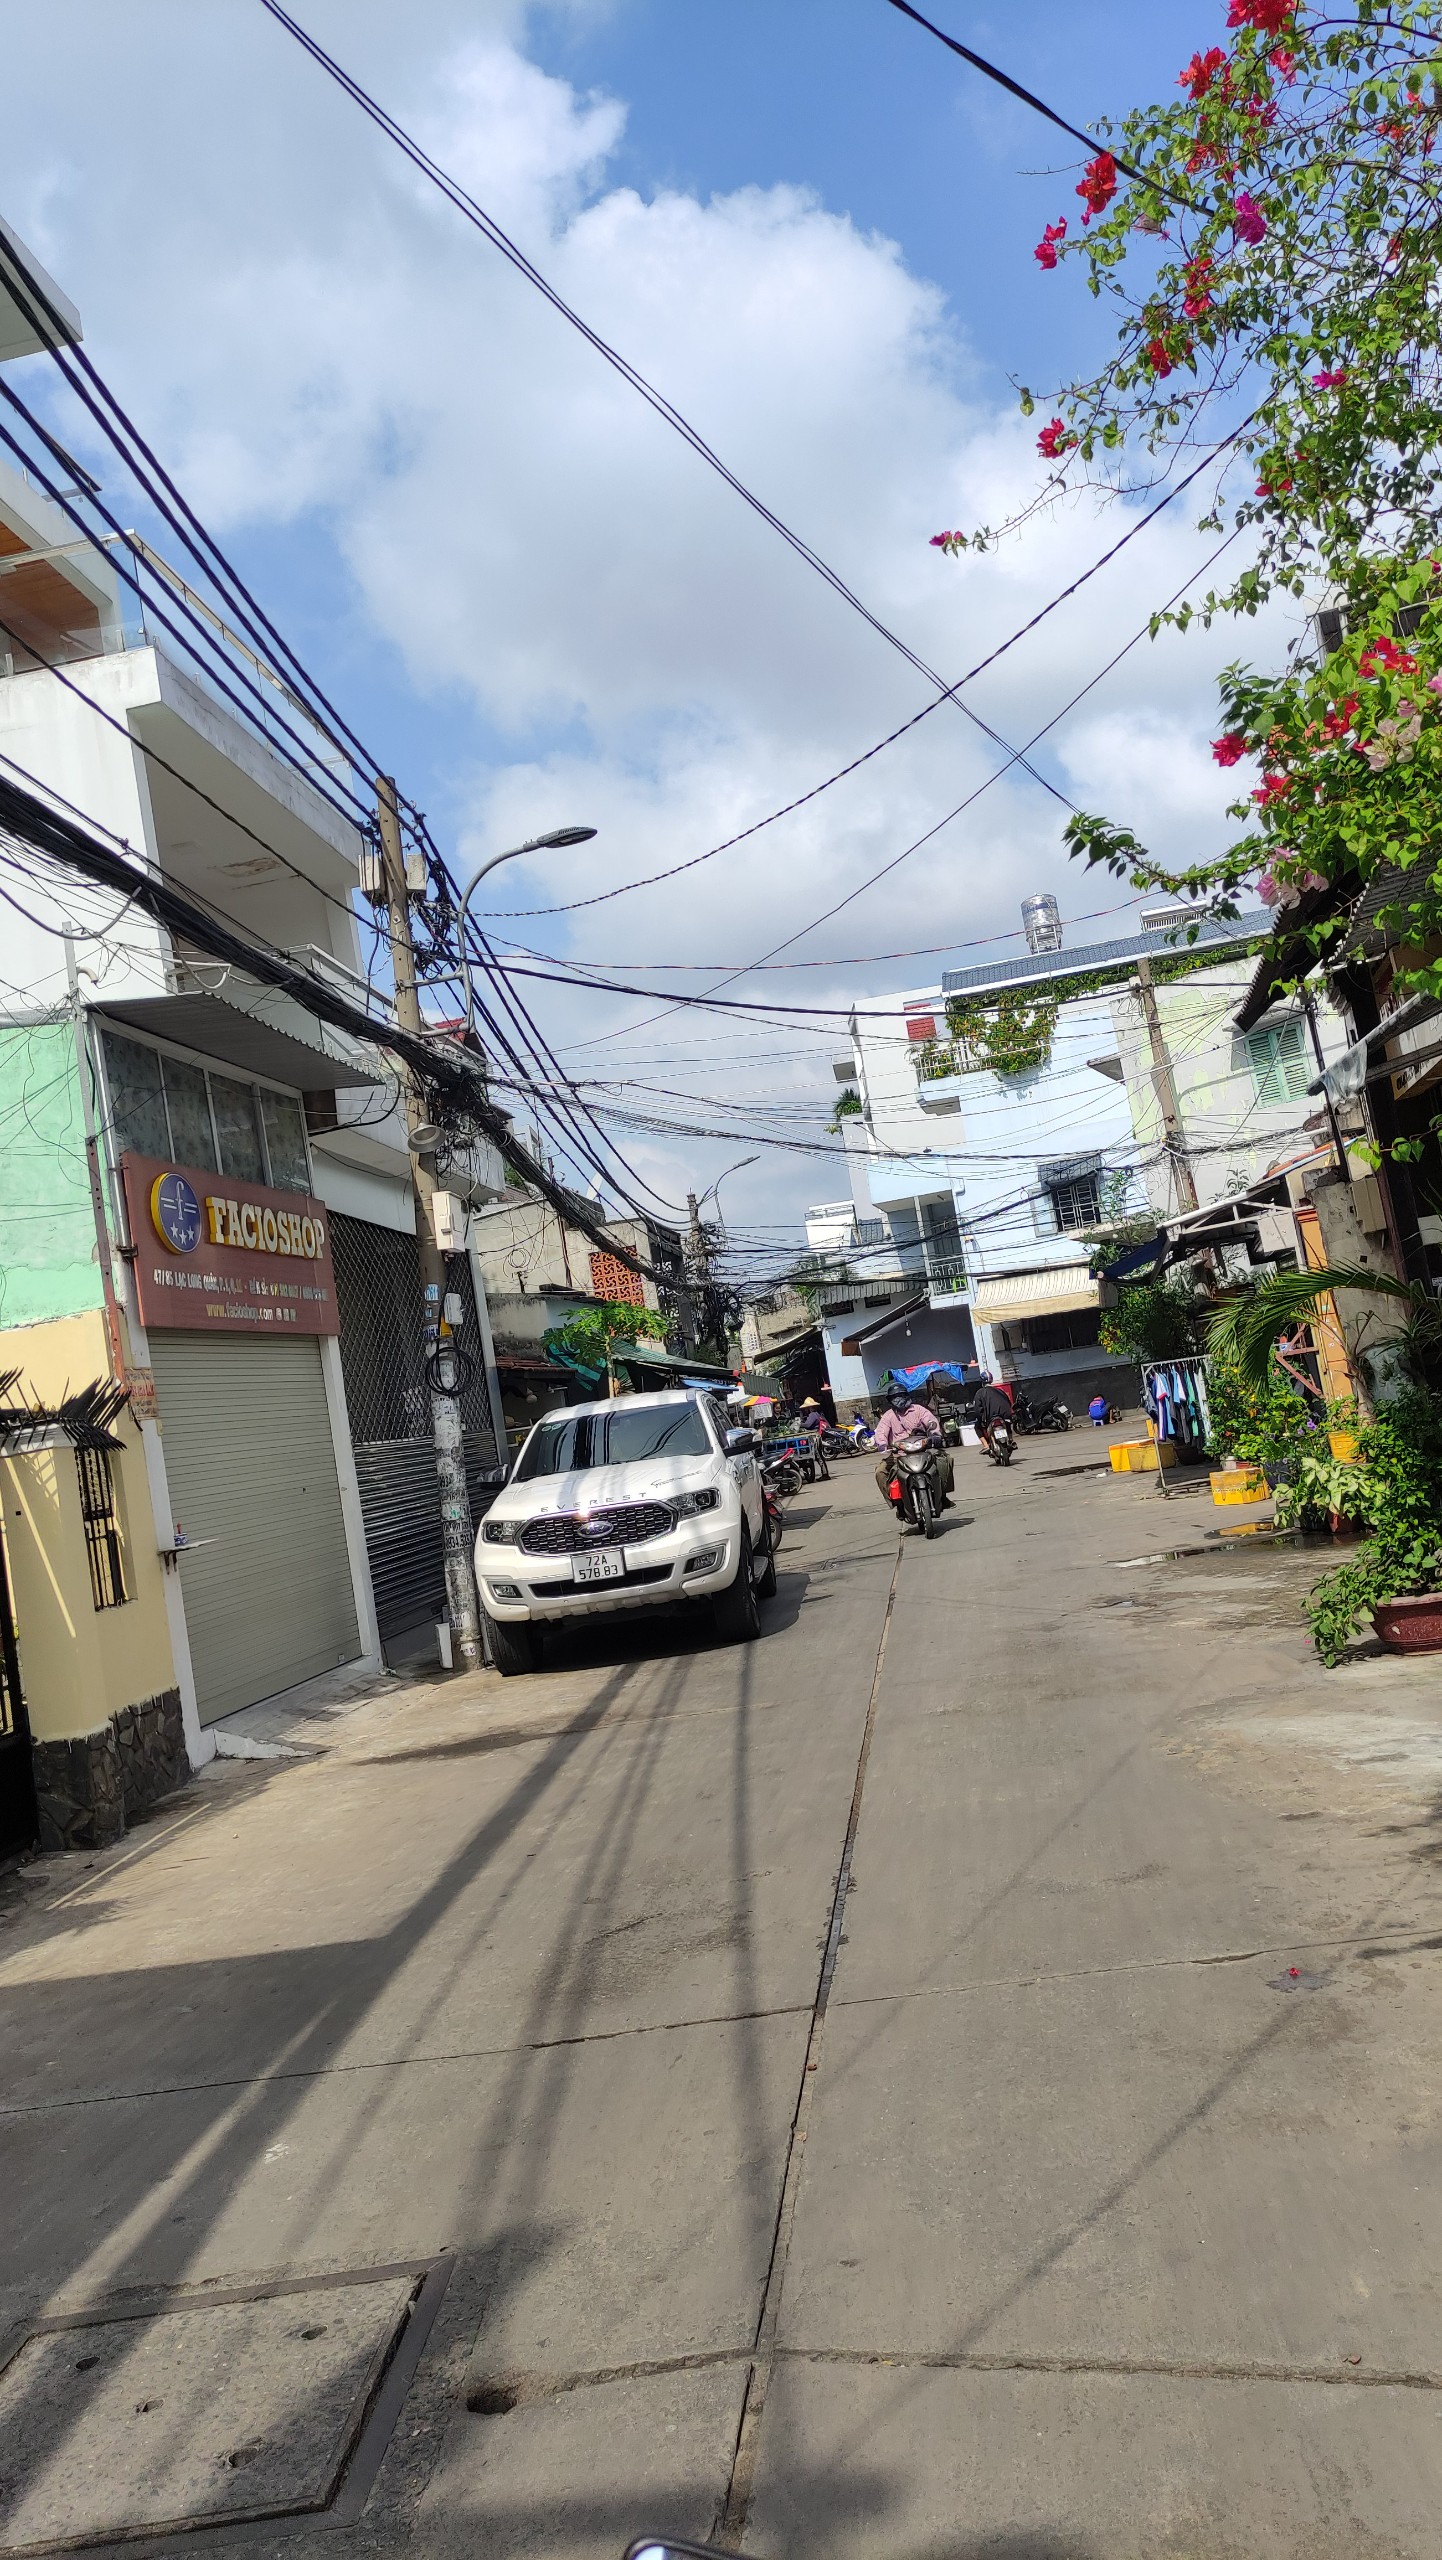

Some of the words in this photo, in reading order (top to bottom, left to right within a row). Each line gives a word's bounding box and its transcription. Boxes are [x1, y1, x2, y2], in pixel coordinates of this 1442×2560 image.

[205, 1196, 325, 1259] FACIOSHOP
[187, 1273, 203, 1289] LONG
[206, 1302, 273, 1323] www.facioshop.com
[540, 1491, 647, 1513] EVEREST
[585, 1554, 608, 1567] 72A
[578, 1564, 618, 1580] 578.83
